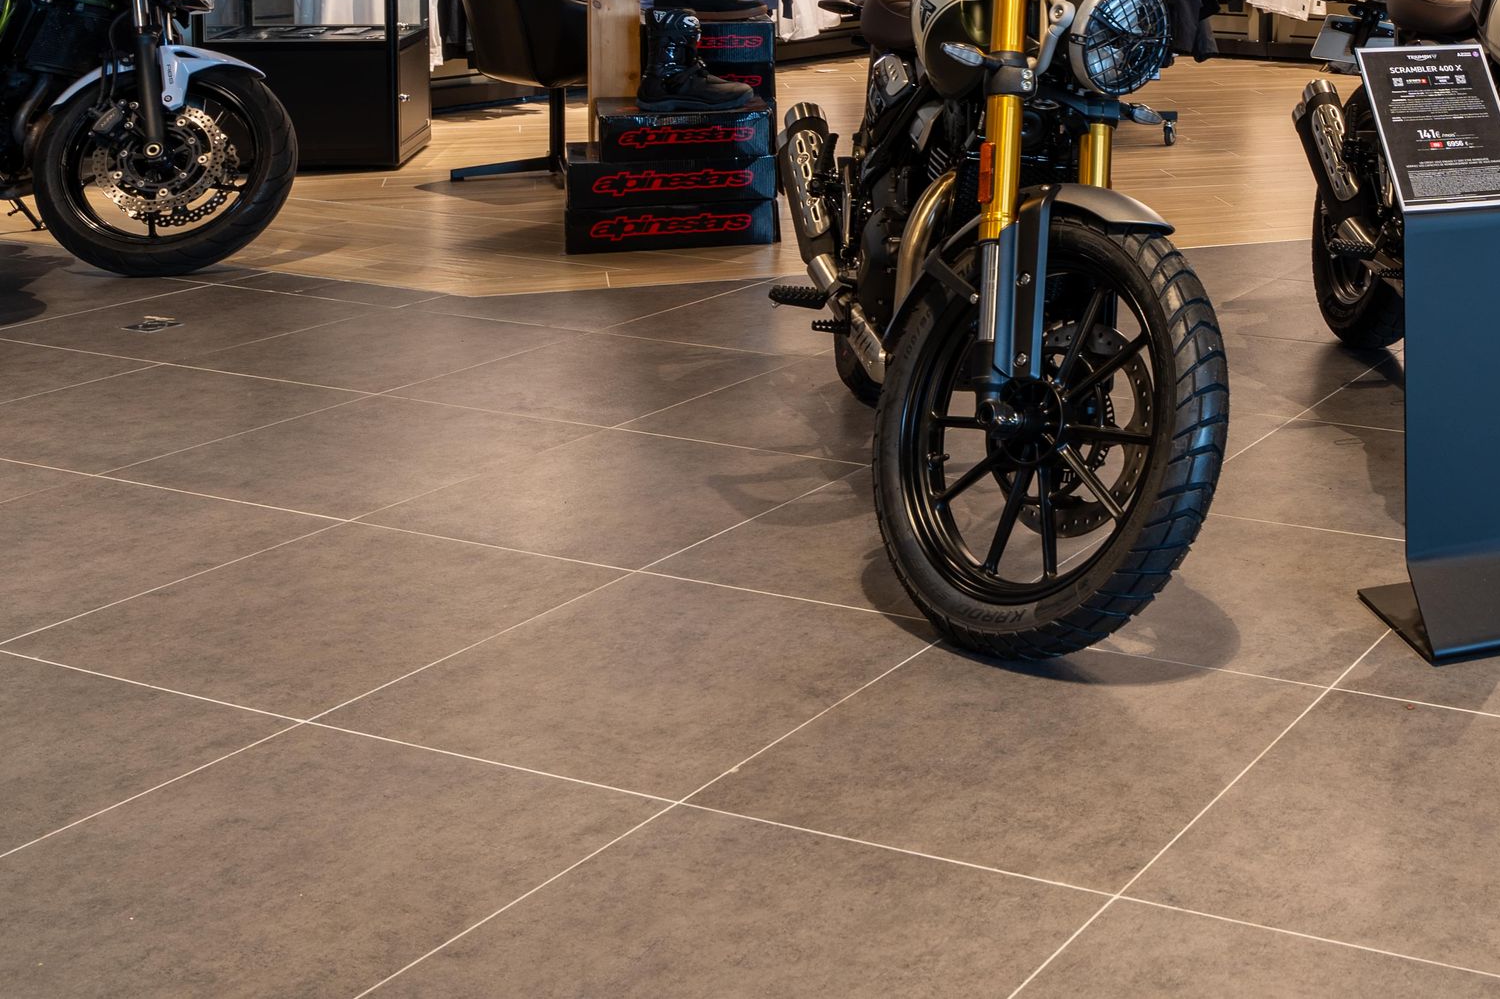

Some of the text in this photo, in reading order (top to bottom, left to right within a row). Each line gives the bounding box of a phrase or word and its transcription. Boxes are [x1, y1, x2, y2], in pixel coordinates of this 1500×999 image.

[1389, 65, 1438, 74] SCRAMBLER
[1455, 64, 1463, 72] X
[618, 125, 756, 148] alpinestars
[592, 169, 753, 196] alpinestars
[589, 212, 752, 241] alpinestars
